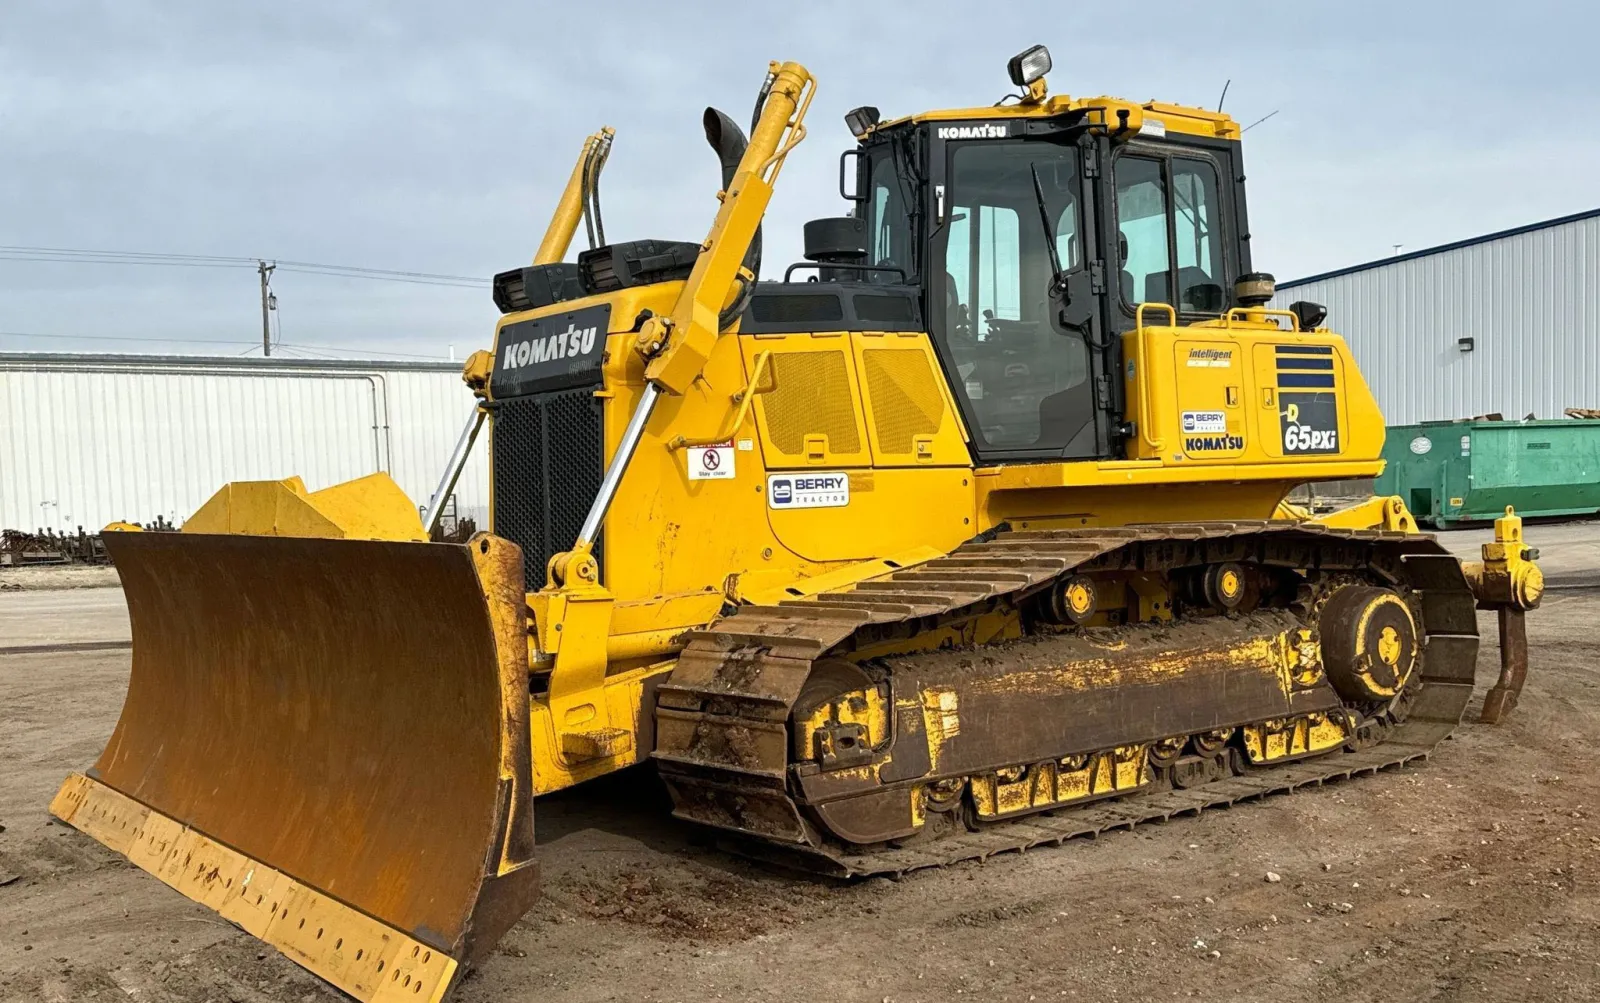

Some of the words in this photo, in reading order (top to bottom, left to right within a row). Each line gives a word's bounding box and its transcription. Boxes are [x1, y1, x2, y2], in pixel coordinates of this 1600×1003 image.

[938, 123, 1006, 139] KOMATSU
[503, 323, 597, 370] KOMATSU
[1189, 348, 1232, 361] intelligent
[1196, 414, 1223, 422] BERRY
[1186, 433, 1244, 452] KOMATSU
[1285, 425, 1336, 451] 65PXi
[795, 477, 844, 490] BERRY
[796, 495, 845, 503] TRACTOR
